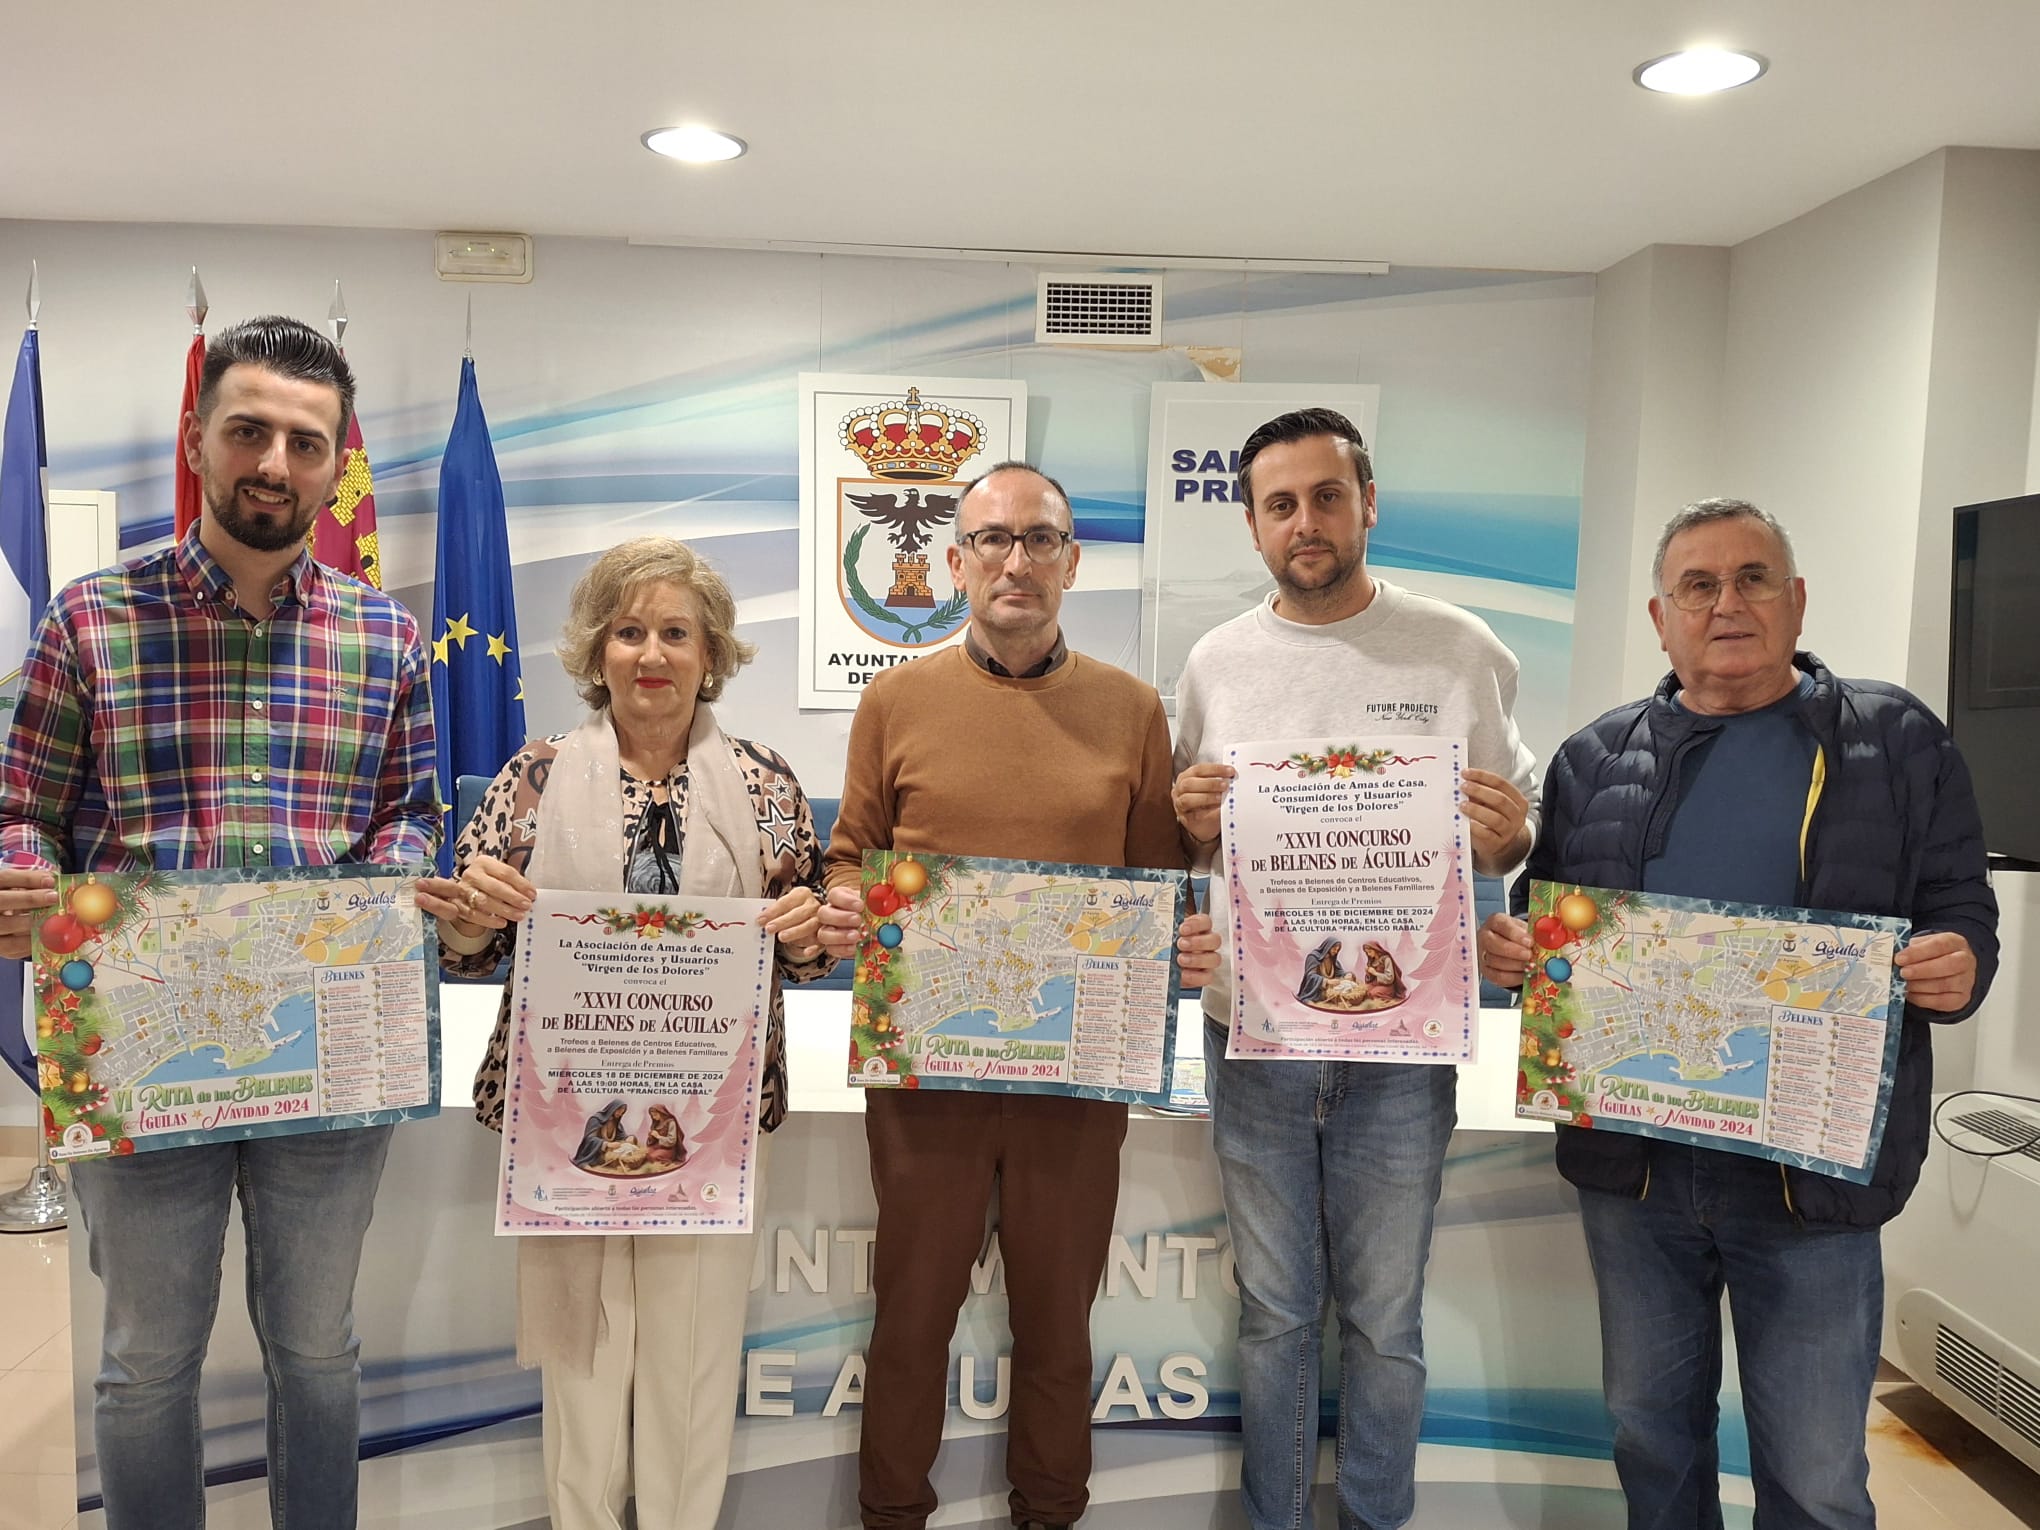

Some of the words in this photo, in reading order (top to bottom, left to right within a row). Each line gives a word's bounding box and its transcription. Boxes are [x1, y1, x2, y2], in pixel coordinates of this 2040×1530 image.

[848, 672, 873, 684] DE
[1367, 703, 1396, 712] FUTURE
[1400, 703, 1438, 714] PROJECTS
[1258, 785, 1270, 793] La
[1273, 783, 1329, 793] Asociación
[1334, 782, 1346, 790] de
[1350, 781, 1379, 789] Amas
[1382, 780, 1395, 788] de
[1272, 793, 1348, 803] Consumidores
[1355, 794, 1361, 802] y
[1364, 791, 1412, 800] Usuarios
[1281, 805, 1318, 815] "Virgen
[1322, 804, 1334, 812] de
[1338, 803, 1353, 812] los
[1357, 801, 1404, 811] Dolores"
[1276, 832, 1321, 849] "XXVI
[1326, 829, 1411, 847] CONCURSO
[1251, 859, 1267, 872] DE
[1271, 853, 1336, 871] BELENES
[1342, 858, 1357, 869] DE
[1363, 848, 1439, 869] ÁGUILAS"
[1308, 886, 1347, 894] Exposición
[1394, 883, 1434, 891] Familiares
[1311, 898, 1340, 907] Entrega
[1351, 897, 1381, 905] Premios
[559, 939, 572, 948] La
[576, 940, 637, 950] Asociación
[641, 943, 653, 951] de
[657, 943, 687, 952] Amas
[690, 944, 702, 953] de
[573, 952, 654, 963] Consumidores
[671, 955, 719, 965] Usuarios
[1082, 958, 1119, 969] BELENES
[321, 970, 365, 983] BELENES
[582, 964, 622, 974] "Virgen
[643, 966, 658, 974] los
[662, 966, 710, 976] Dolores"
[573, 992, 621, 1009] "XXVI
[627, 992, 713, 1012] CONCURSO
[541, 1017, 559, 1029] DE
[564, 1014, 634, 1032] BELENES
[639, 1020, 656, 1032] DE
[660, 1012, 738, 1033] ÁGUILAS"
[1778, 1010, 1823, 1025] BELENES
[600, 1047, 641, 1056] Exposición
[905, 1035, 922, 1054] VI
[926, 1034, 970, 1058] RUTA
[972, 1047, 984, 1056] de
[986, 1048, 999, 1058] los
[1000, 1039, 1065, 1061] BELENES
[601, 1059, 631, 1069] Entrega
[974, 1060, 1028, 1080] NAVIDAD
[1032, 1065, 1060, 1076] 2024
[112, 1089, 133, 1113] VI
[138, 1083, 194, 1111] RUTA
[196, 1092, 211, 1103] de
[214, 1090, 233, 1101] los
[232, 1074, 313, 1103] BELENES
[1579, 1074, 1596, 1093] VI
[1600, 1075, 1649, 1101] RUTA
[1652, 1091, 1665, 1103] de
[1667, 1094, 1682, 1106] los
[1682, 1090, 1760, 1119] BELENES
[202, 1102, 269, 1131] NAVIDAD
[274, 1098, 309, 1115] 2024
[1654, 1109, 1715, 1128] NAVIDAD
[1720, 1119, 1753, 1135] 2024
